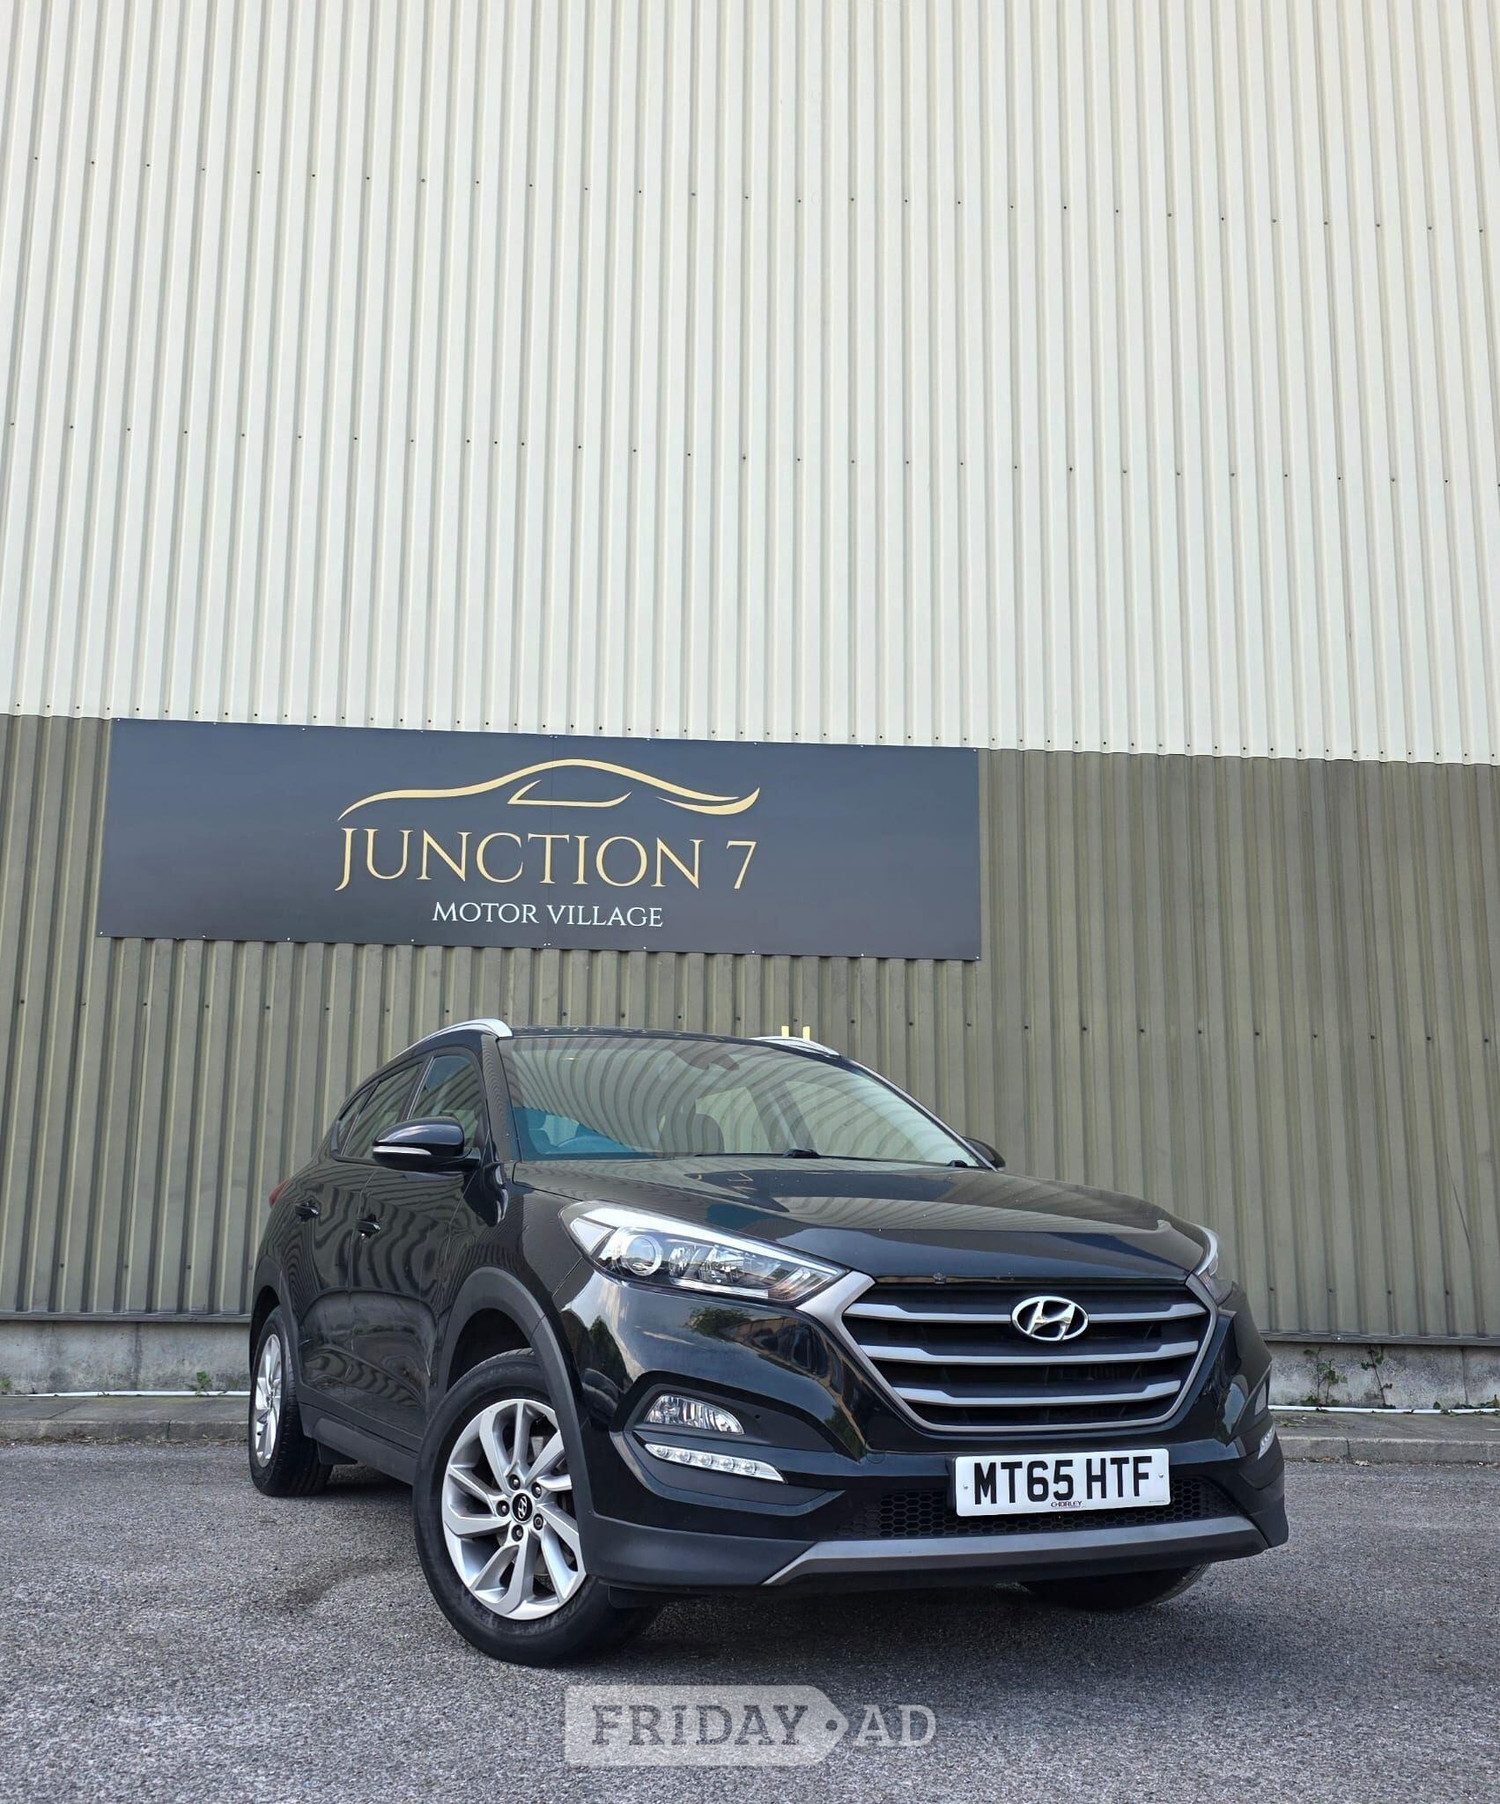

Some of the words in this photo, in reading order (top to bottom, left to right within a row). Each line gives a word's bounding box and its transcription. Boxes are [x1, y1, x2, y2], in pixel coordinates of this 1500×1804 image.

[334, 827, 704, 892] JUNCTION
[724, 840, 759, 891] 7
[432, 901, 540, 925] MOTOR
[545, 904, 664, 928] VILLAGE
[974, 1459, 1075, 1506] MT65
[1086, 1455, 1153, 1500] HTF
